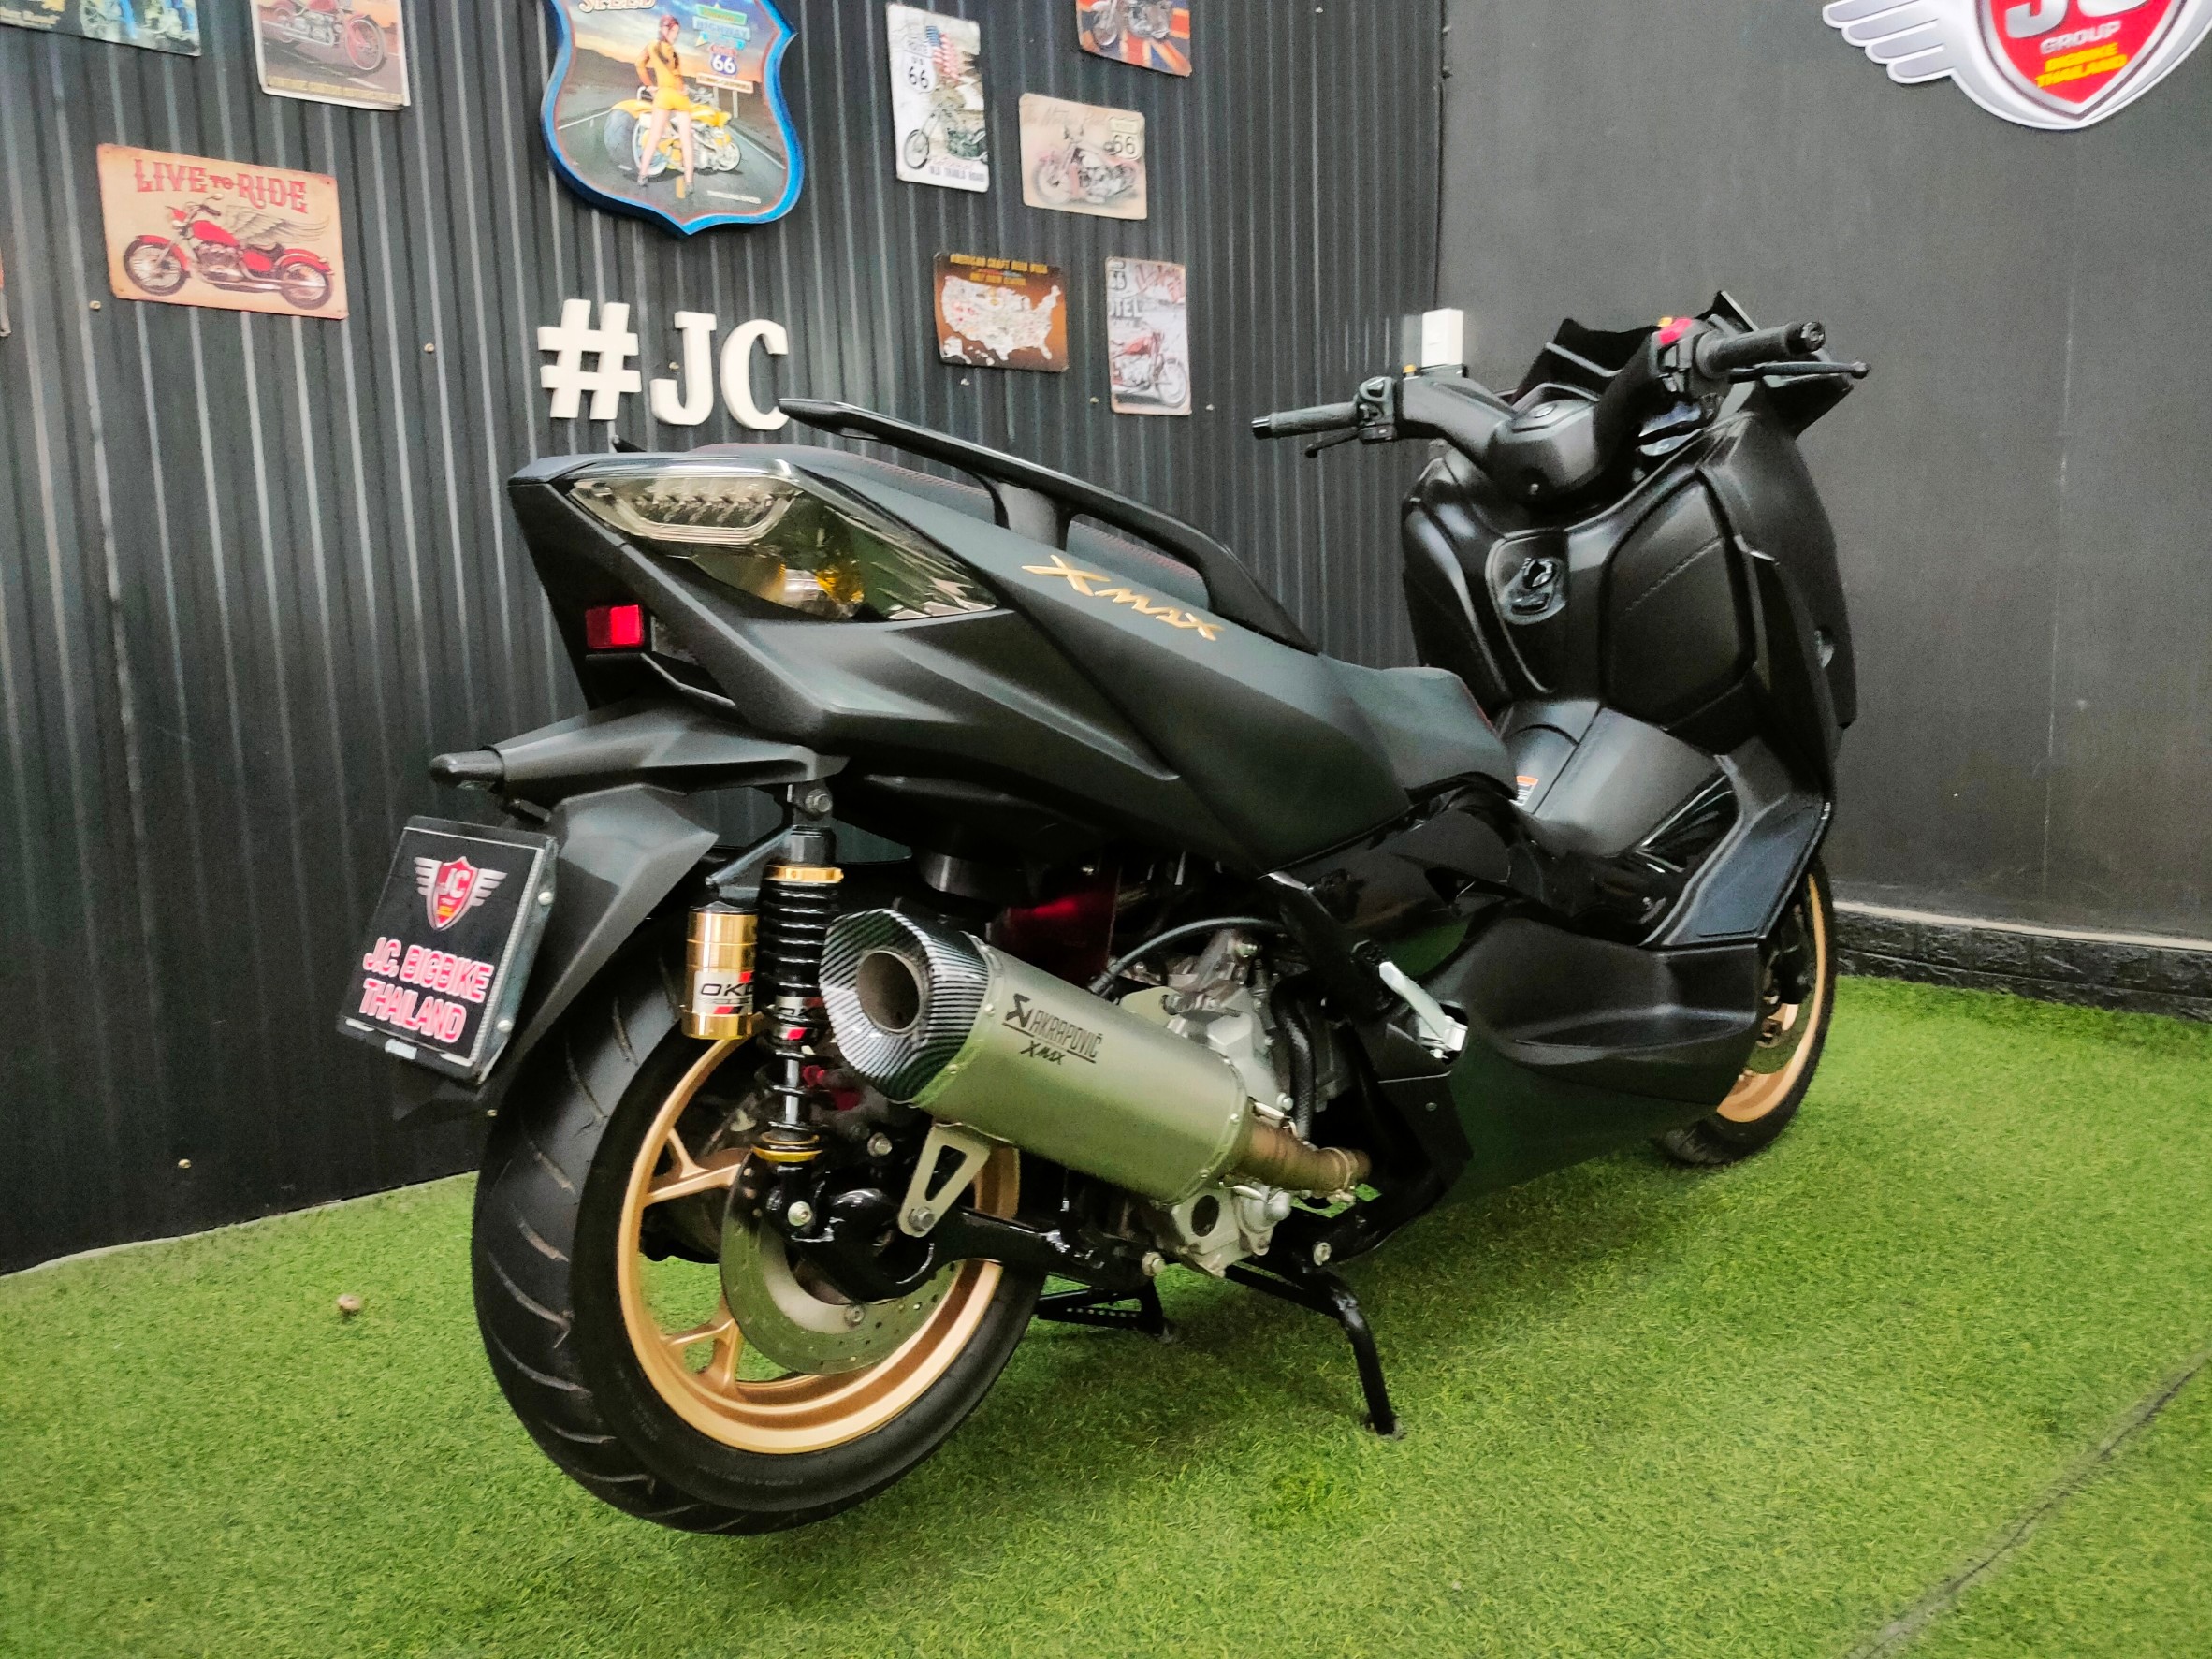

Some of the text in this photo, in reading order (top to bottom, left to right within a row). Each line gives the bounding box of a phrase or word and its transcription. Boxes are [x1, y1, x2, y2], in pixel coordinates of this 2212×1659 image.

[2040, 20, 2122, 55] GROUP
[712, 55, 736, 74] 66
[908, 66, 929, 89] 66
[2034, 53, 2129, 88] THAILAND
[1113, 134, 1135, 155] 66
[134, 159, 308, 214] LIVE TO RIDE
[400, 944, 495, 1003] BIGBIKE
[359, 978, 467, 1043] THAILAND
